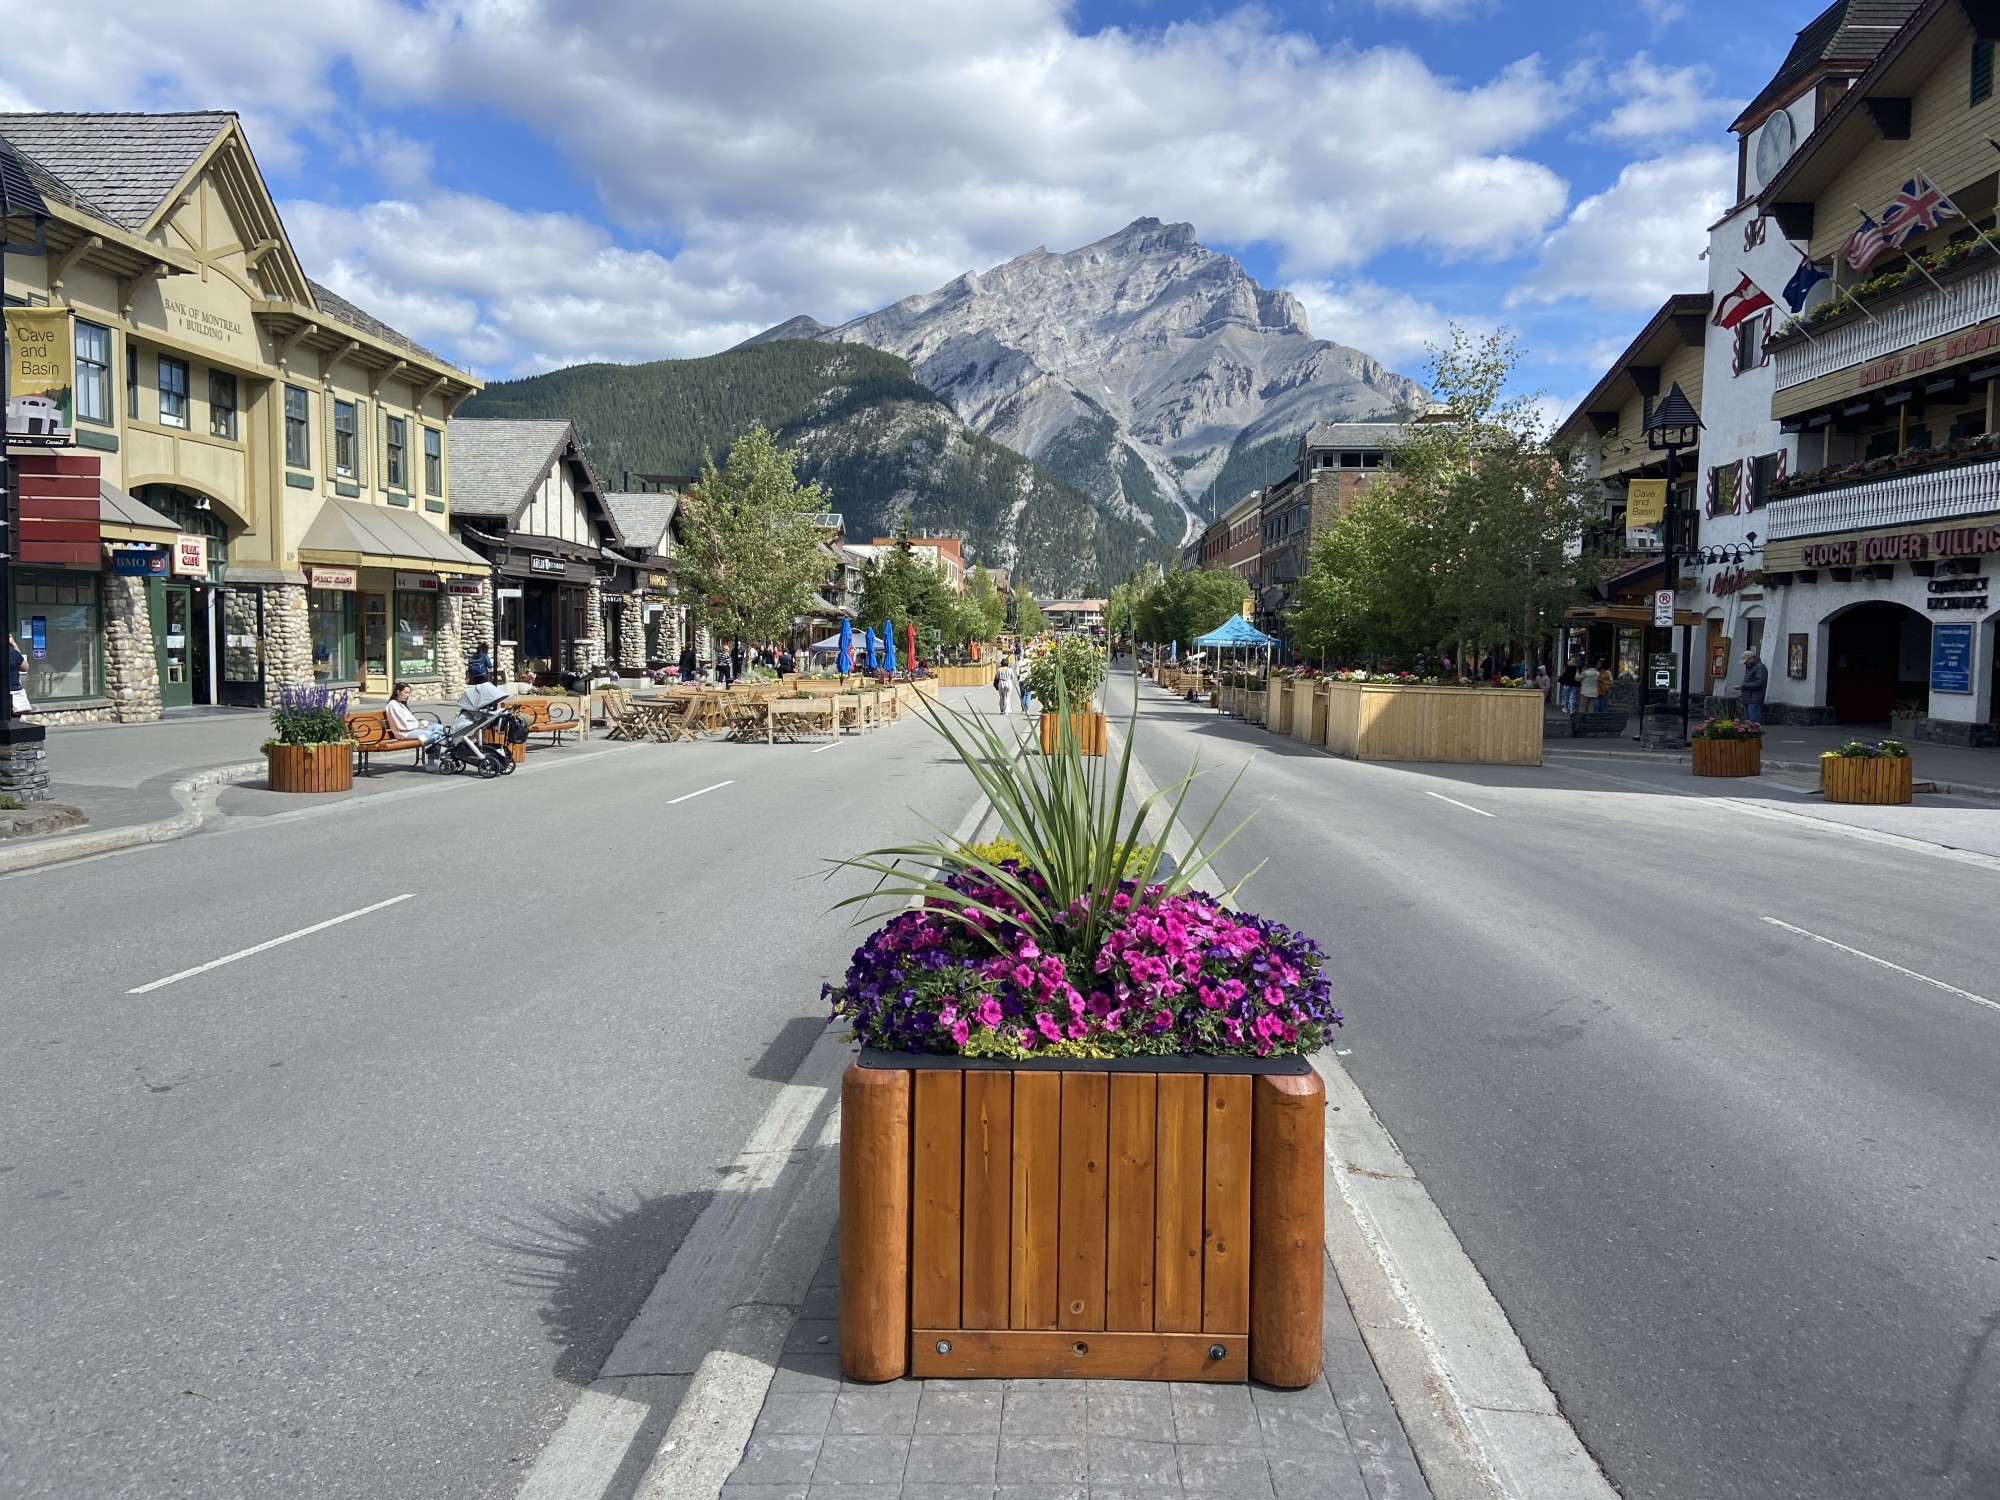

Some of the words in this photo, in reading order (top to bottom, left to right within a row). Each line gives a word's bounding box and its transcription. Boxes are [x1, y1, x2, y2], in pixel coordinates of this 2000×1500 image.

[164, 297, 187, 316] BANK
[188, 306, 200, 320] OF
[201, 311, 243, 335] MONTREAL
[17, 327, 55, 342] Cave
[186, 318, 223, 341] BUILDING
[20, 343, 47, 358] and
[21, 361, 59, 375] Basin
[1859, 357, 1902, 388] BANFF
[1633, 489, 1656, 498] Cave
[1632, 498, 1650, 507] and
[1632, 507, 1656, 516] Basin
[1802, 541, 1853, 567] CLOCK
[1859, 533, 1923, 563] TOWER
[116, 557, 146, 568] BMO
